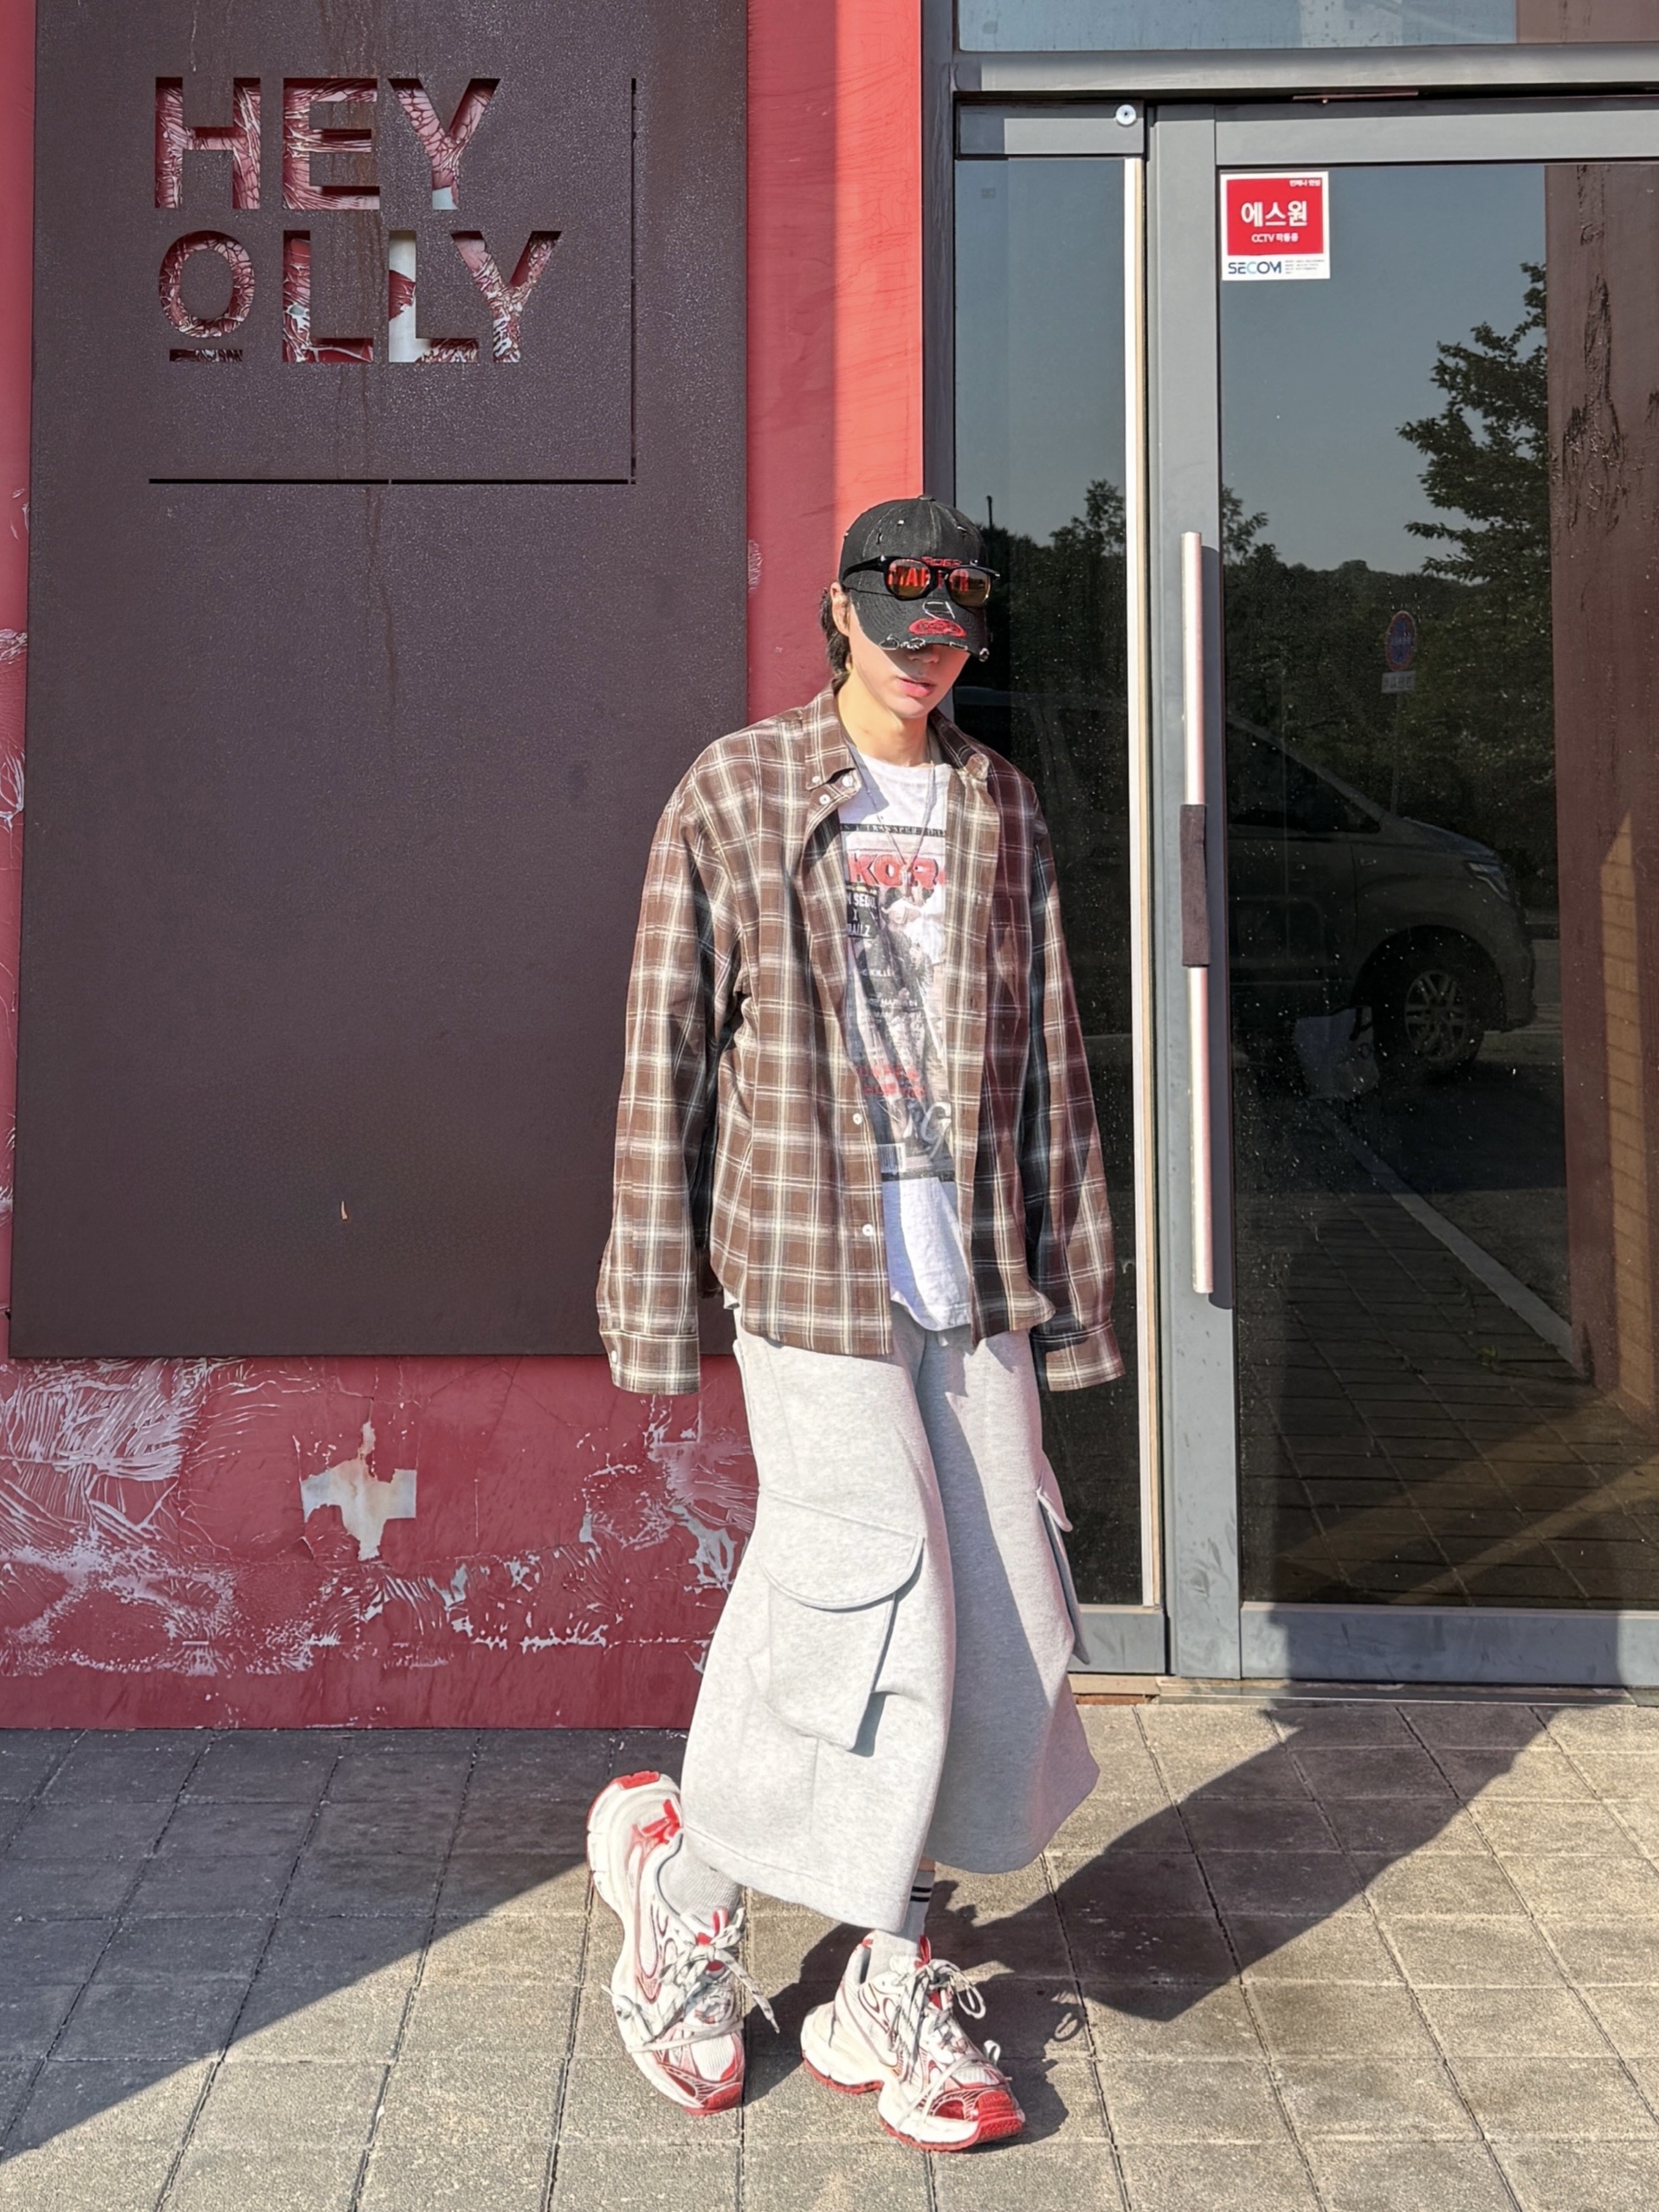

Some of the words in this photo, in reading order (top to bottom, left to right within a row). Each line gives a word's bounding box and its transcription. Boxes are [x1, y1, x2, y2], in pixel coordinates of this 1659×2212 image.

[155, 76, 500, 210] HEY
[1241, 200, 1307, 227] 에스원
[1251, 233, 1275, 243] CCTV
[1228, 261, 1281, 275] SECOM
[158, 230, 562, 363] OLLY
